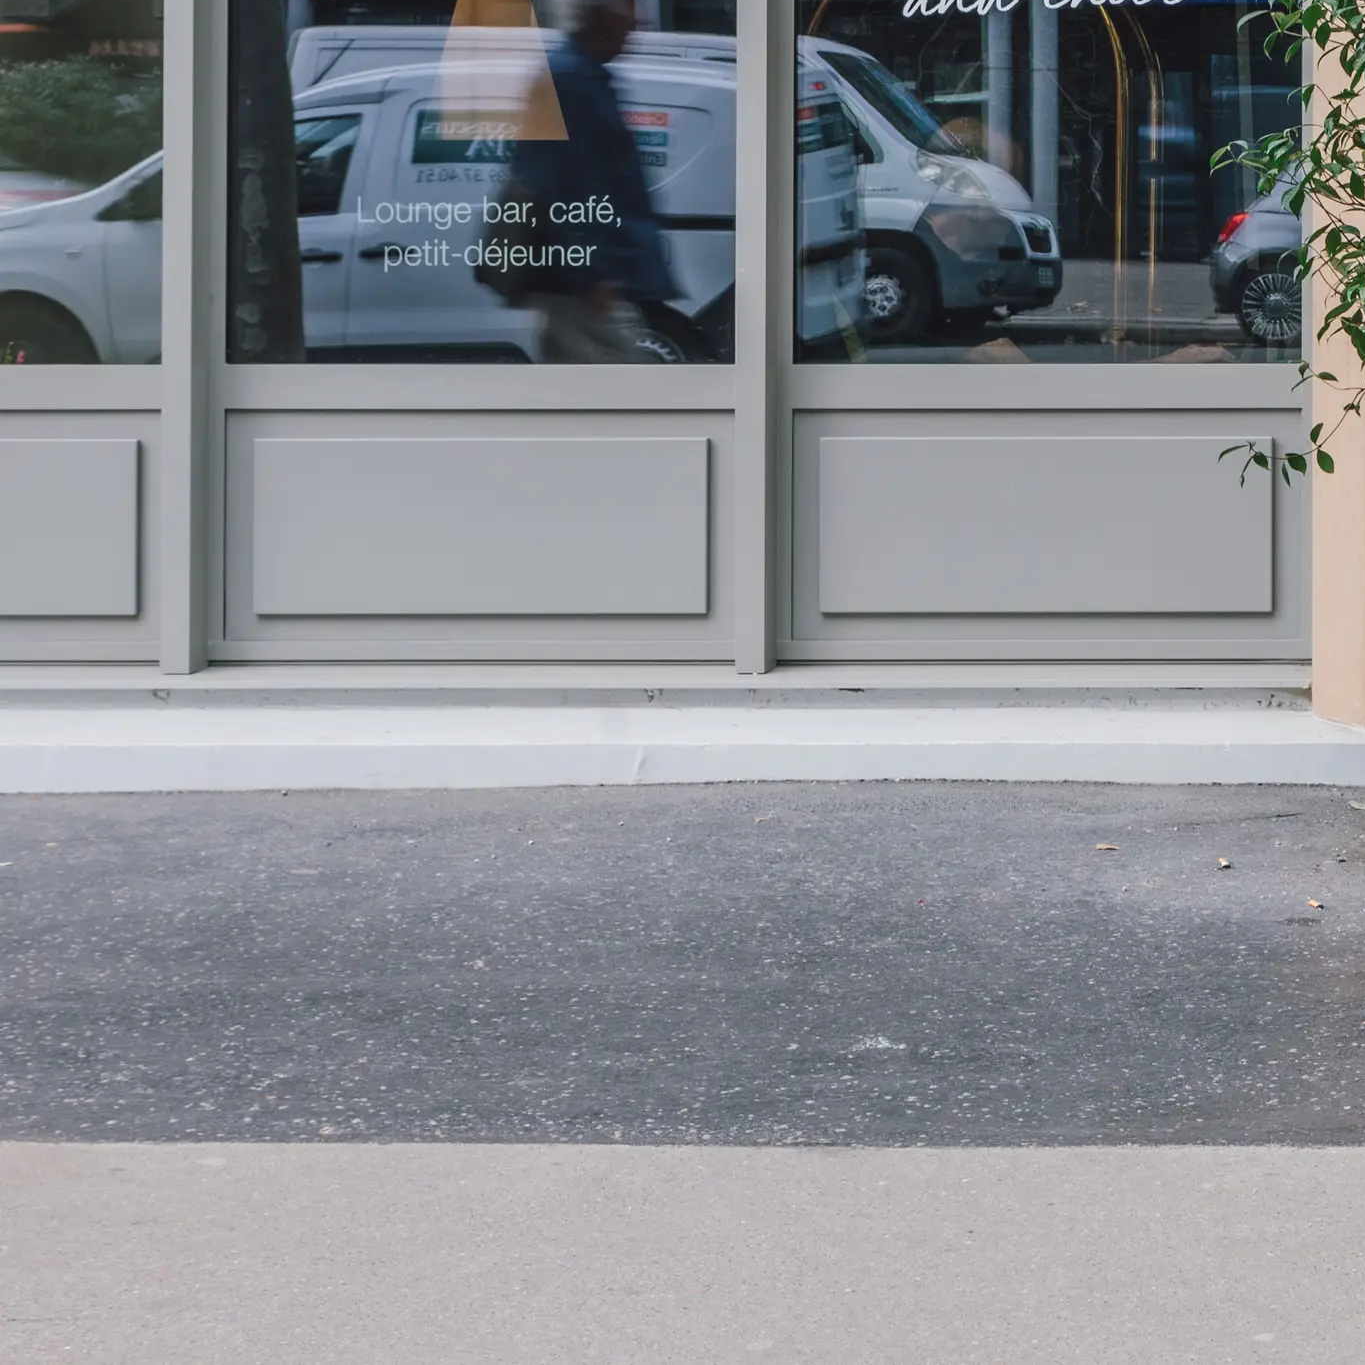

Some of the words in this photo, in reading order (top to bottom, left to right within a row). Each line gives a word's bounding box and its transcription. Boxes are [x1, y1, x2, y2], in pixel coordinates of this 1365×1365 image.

[357, 195, 472, 230] Lounge
[482, 195, 537, 228] bar,
[549, 194, 622, 228] café,
[384, 238, 598, 273] petit-déjeuner
